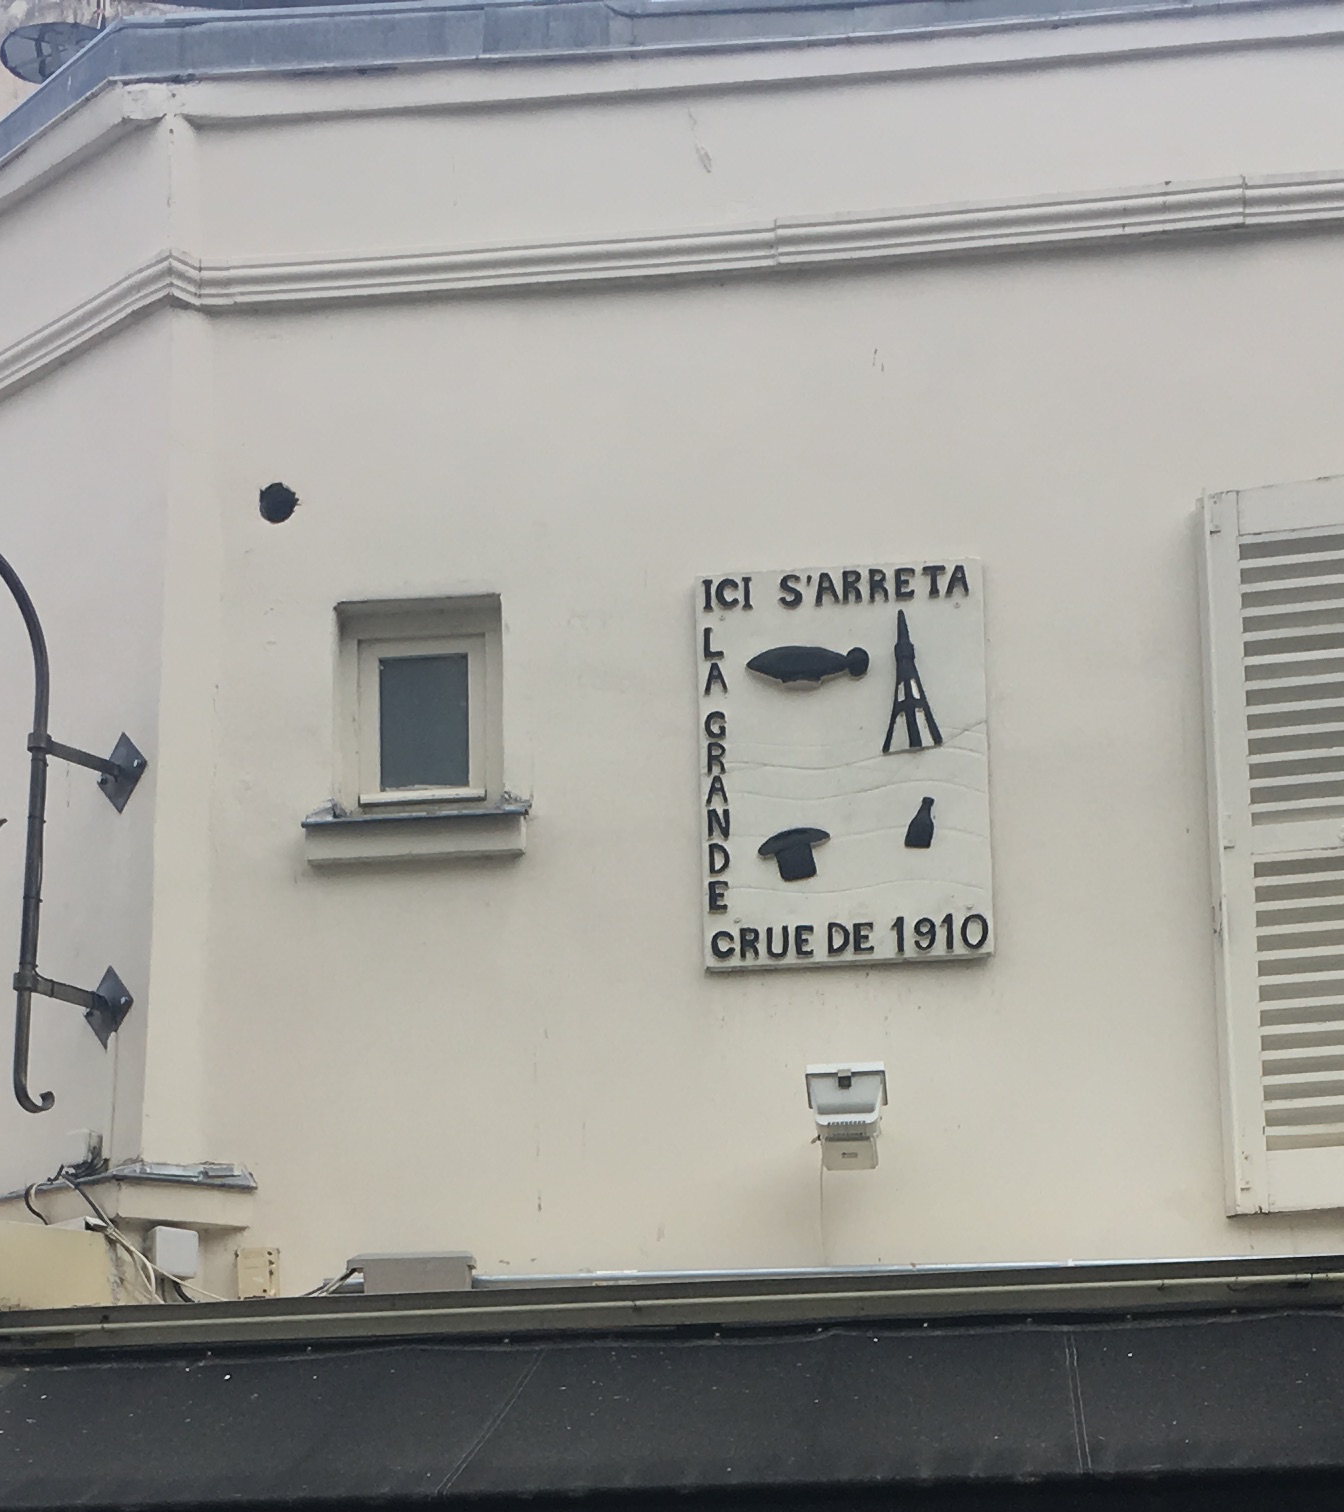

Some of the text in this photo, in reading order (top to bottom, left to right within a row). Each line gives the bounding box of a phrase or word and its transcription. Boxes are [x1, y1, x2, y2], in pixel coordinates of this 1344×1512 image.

[701, 564, 970, 613] ICI S'ARRETA
[702, 626, 732, 915] LA GRANDE
[710, 912, 990, 962] CRUE DE 1910
